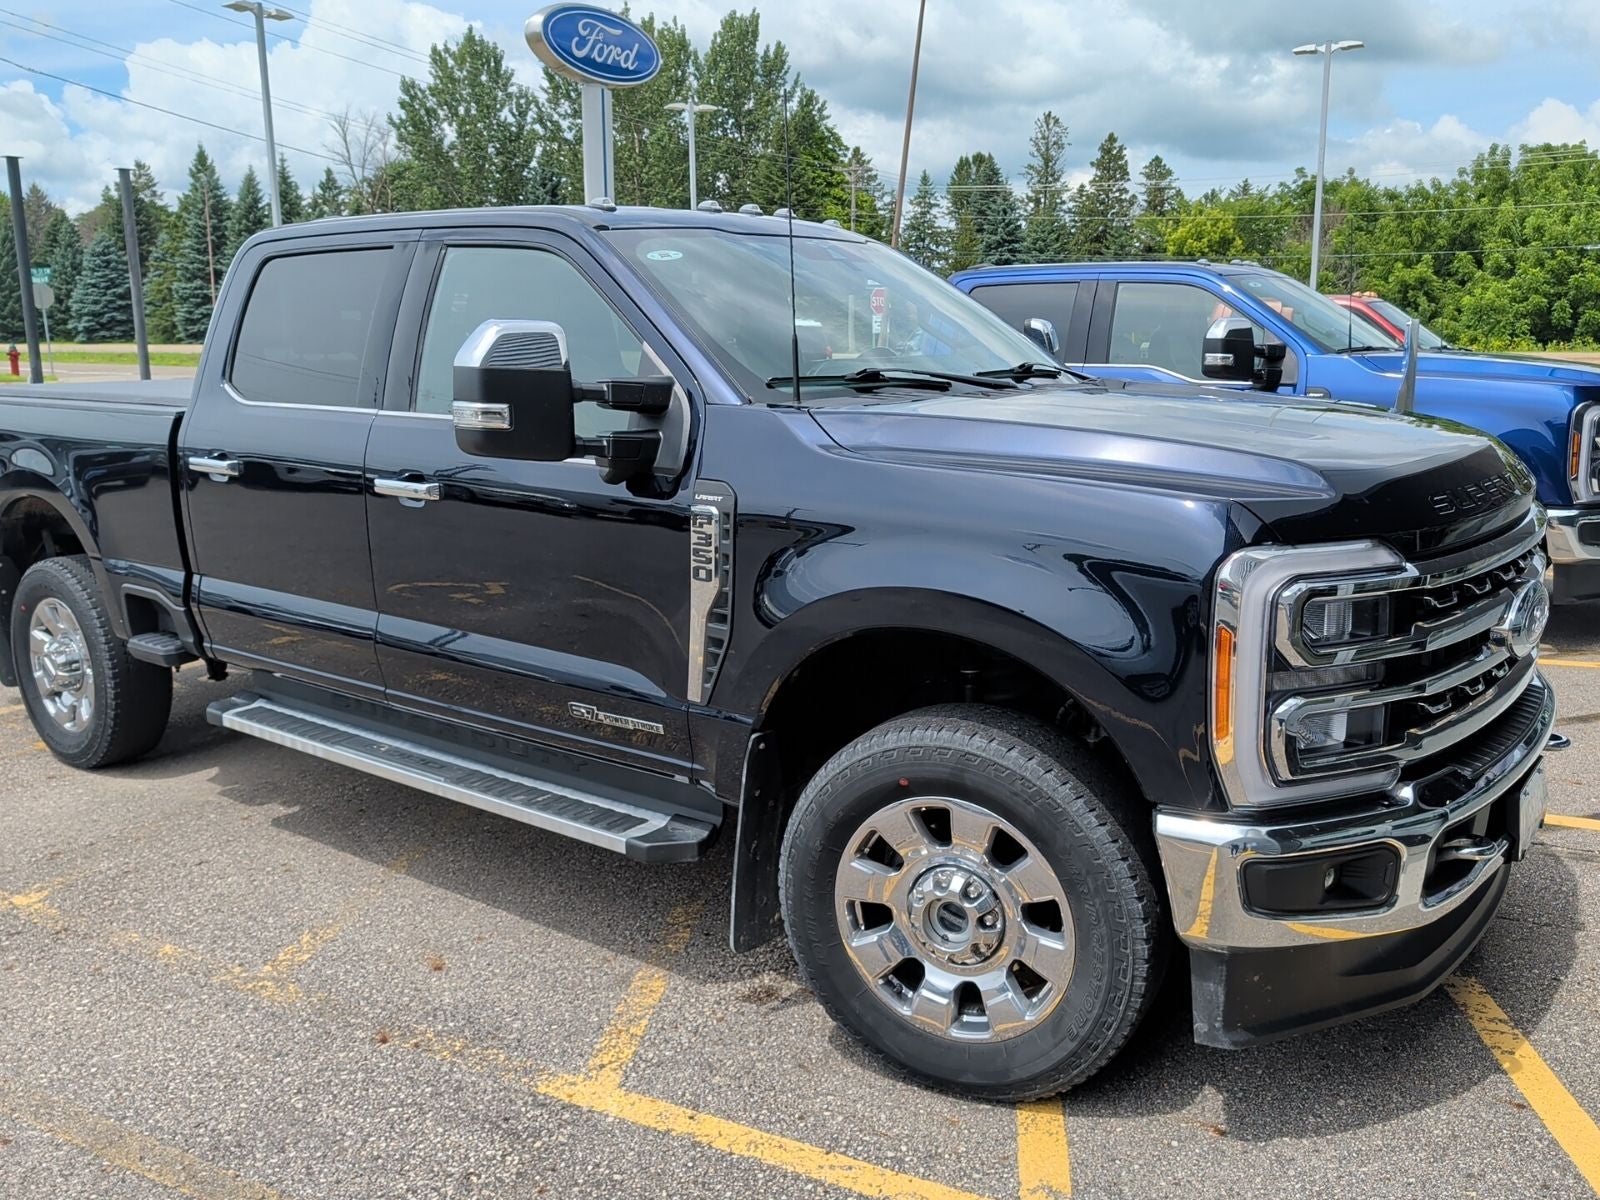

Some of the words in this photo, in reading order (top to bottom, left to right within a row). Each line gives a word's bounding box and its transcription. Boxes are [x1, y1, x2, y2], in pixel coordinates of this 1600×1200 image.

[571, 18, 639, 71] Ford
[604, 714, 631, 727] POWER
[632, 720, 662, 733] STROKE
